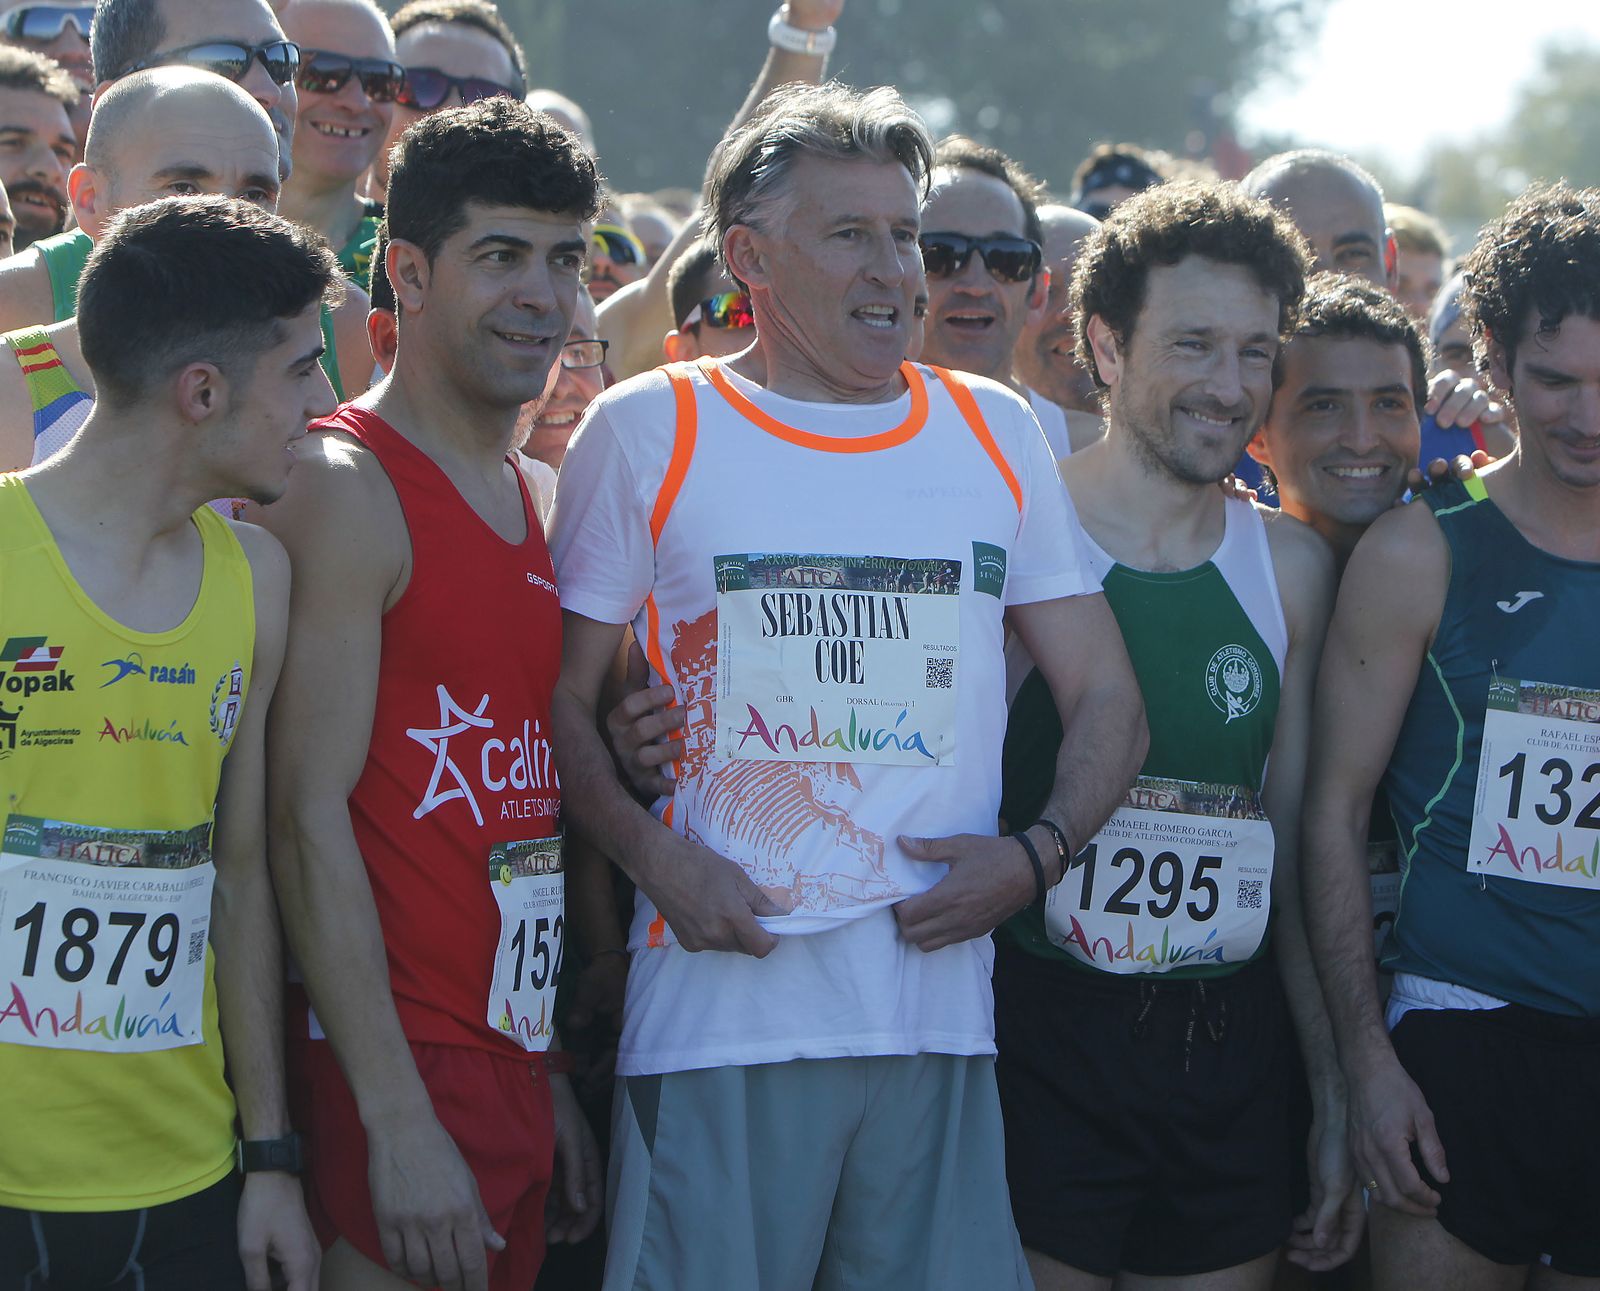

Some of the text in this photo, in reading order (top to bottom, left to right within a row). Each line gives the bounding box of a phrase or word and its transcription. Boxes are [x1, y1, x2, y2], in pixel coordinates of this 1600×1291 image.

[762, 554, 942, 572] XXXVI CROSS INTERNACIONAL
[760, 593, 910, 640] SEBASTIAN
[923, 644, 957, 652] RESULTADOS
[1216, 647, 1247, 662] ATLETISMO
[815, 640, 865, 685] COE
[1209, 661, 1218, 673] DE
[149, 662, 196, 685] rasán
[1208, 676, 1218, 696] CLUB
[1535, 683, 1570, 697] XXXVI
[775, 694, 794, 703] GBR
[846, 697, 880, 706] DORSAL
[1533, 696, 1600, 721] ITALIC
[20, 728, 81, 738] Ayuntamiento
[97, 716, 190, 747] Andalucía
[735, 703, 936, 760] Andalucía
[1540, 728, 1581, 742] RAFAEL
[33, 737, 74, 747] Algeciras
[1526, 738, 1550, 748] CLUB
[1551, 740, 1563, 749] DE
[1499, 752, 1600, 830] 132
[1106, 818, 1234, 839] ISMAEEL ROMERO GARCIA
[1134, 833, 1179, 843] ATLETISMO
[1180, 837, 1221, 847] CORDOBES
[24, 870, 90, 888] FRANCISCO
[93, 879, 130, 891] JAVIER
[1070, 843, 1223, 922] 1295
[532, 887, 549, 898] ANGEL
[14, 901, 180, 988] 1879
[1061, 914, 1226, 965] Andalucía
[0, 981, 184, 1041] Andalucía
